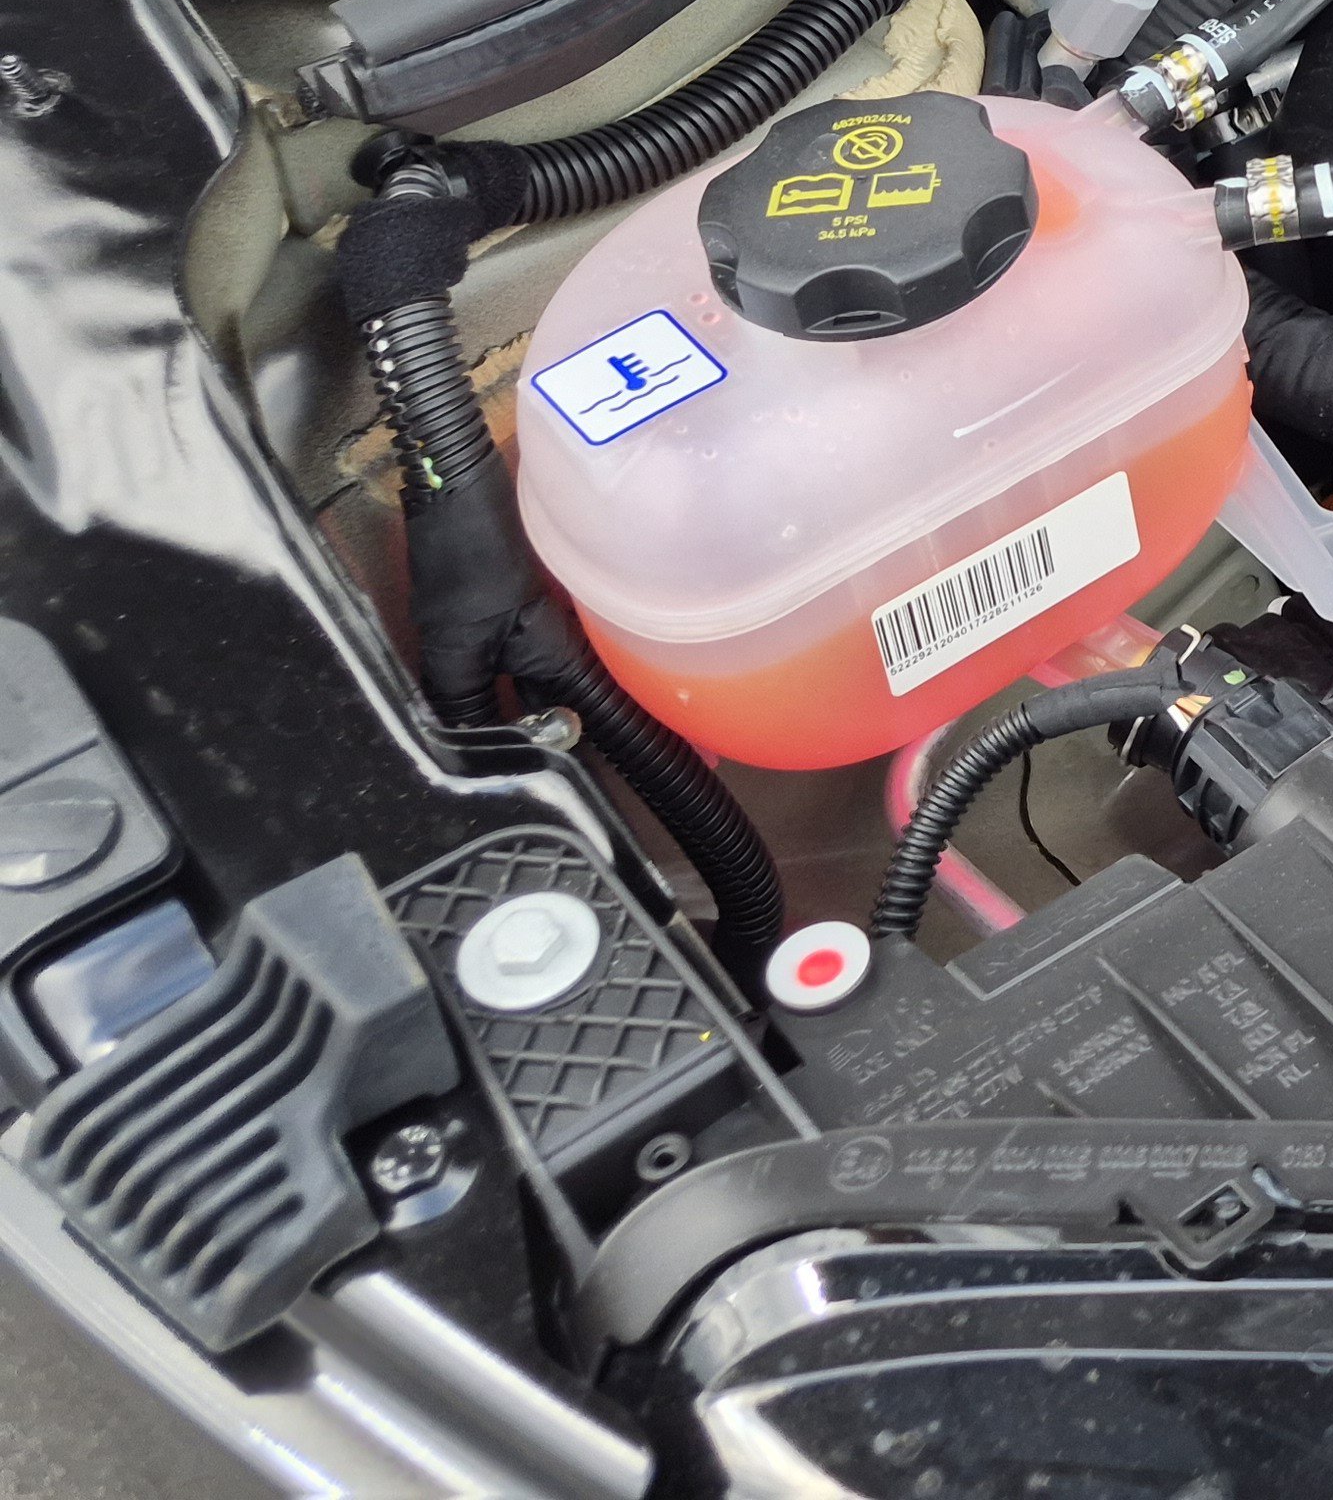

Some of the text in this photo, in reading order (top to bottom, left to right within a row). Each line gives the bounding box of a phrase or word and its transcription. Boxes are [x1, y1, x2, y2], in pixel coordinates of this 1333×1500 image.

[832, 113, 913, 131] 68290247AA
[832, 214, 868, 226] 5 PSI
[818, 227, 876, 241] 34.5 kPa
[889, 583, 1044, 677] 5222921204017228211126
